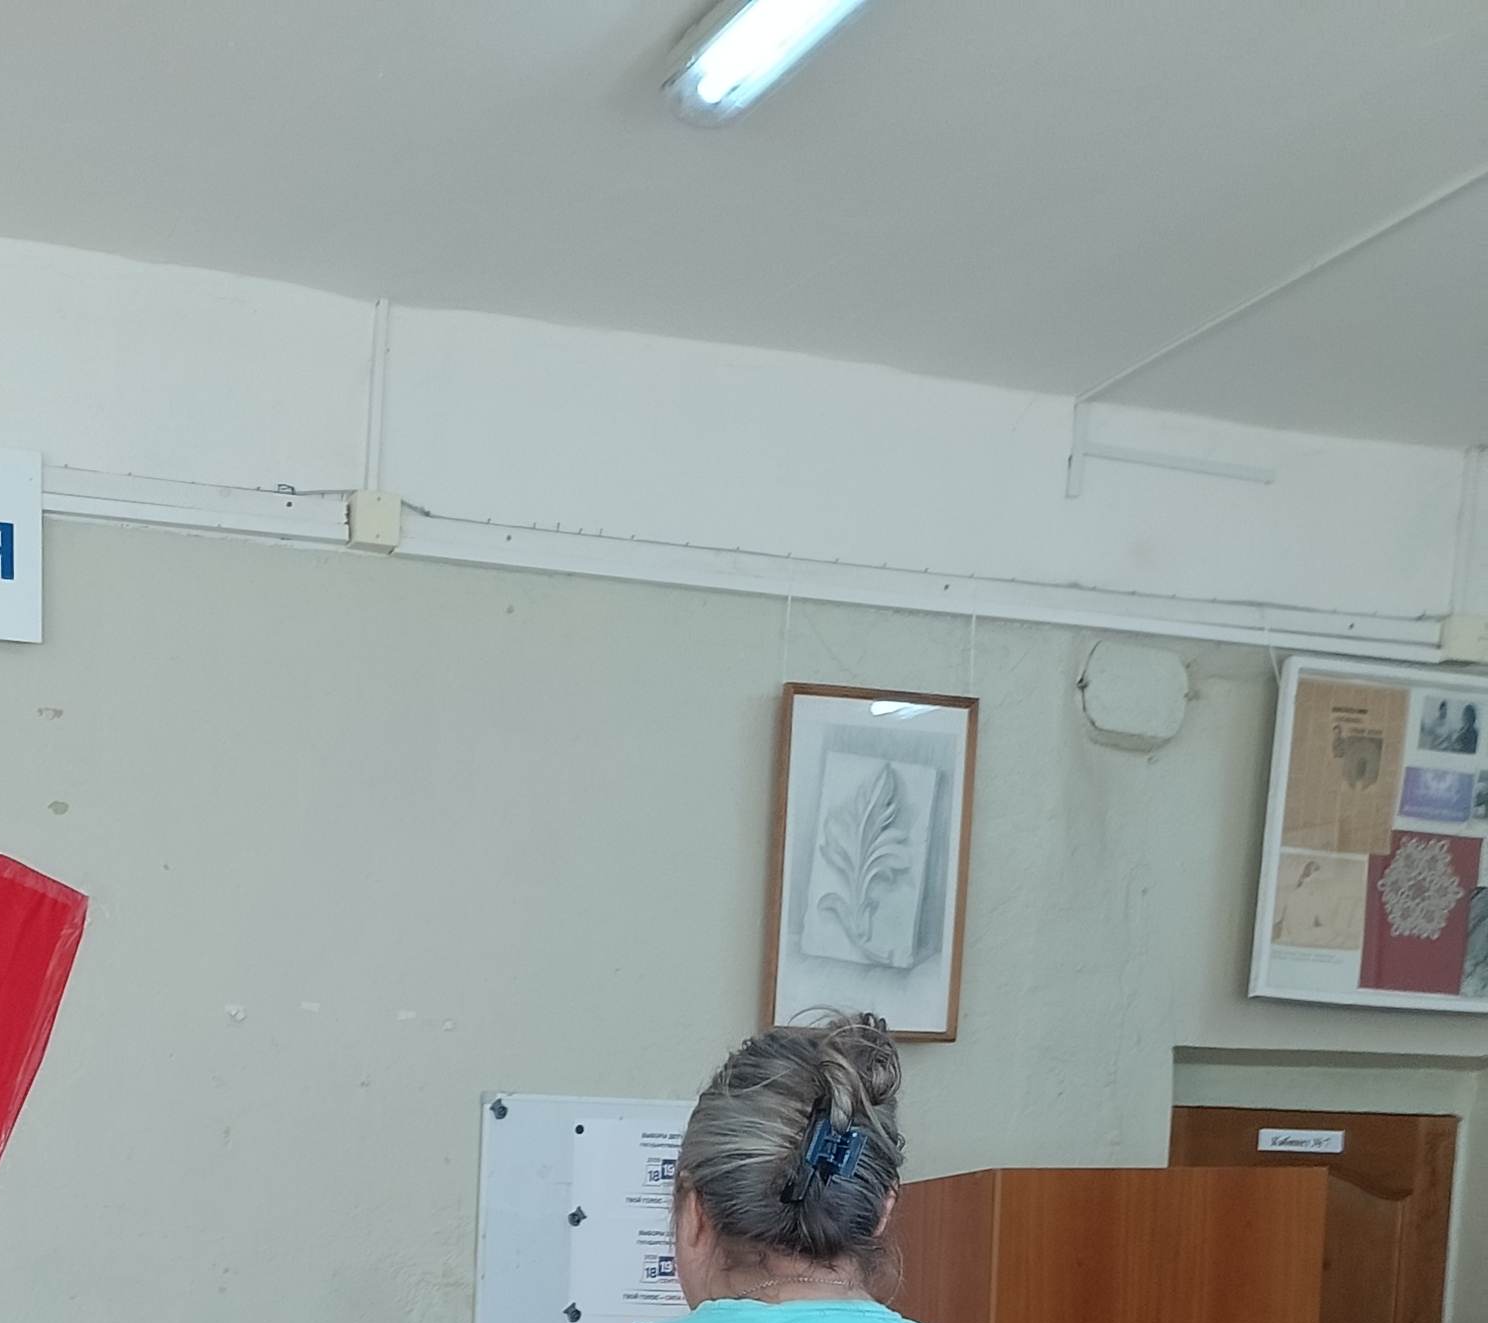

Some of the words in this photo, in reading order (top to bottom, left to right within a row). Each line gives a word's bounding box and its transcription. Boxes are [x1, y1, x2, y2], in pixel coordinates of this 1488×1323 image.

[647, 1170, 660, 1182] 18
[645, 1267, 657, 1278] 18
[659, 1261, 672, 1272] 19
